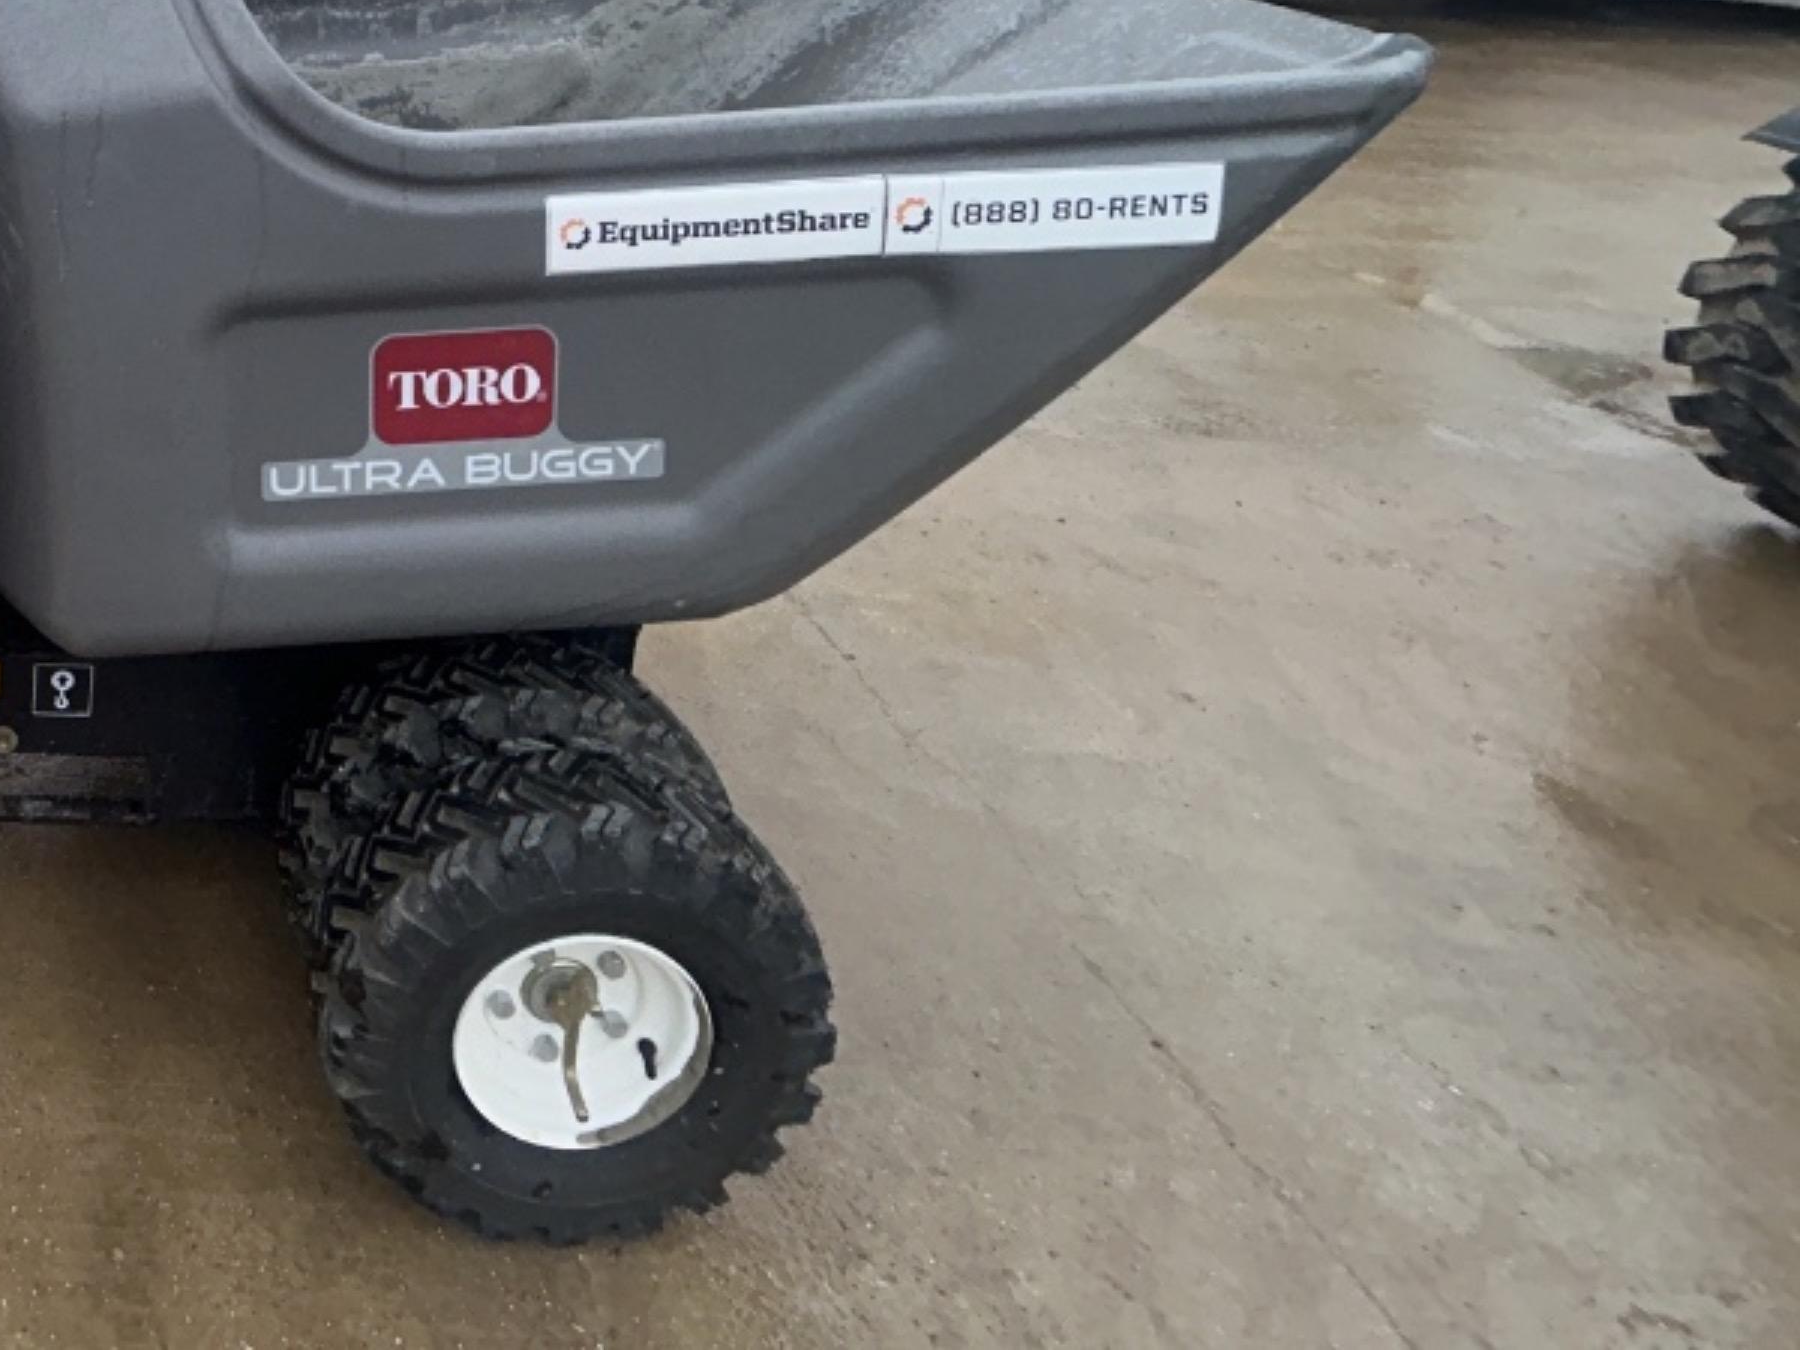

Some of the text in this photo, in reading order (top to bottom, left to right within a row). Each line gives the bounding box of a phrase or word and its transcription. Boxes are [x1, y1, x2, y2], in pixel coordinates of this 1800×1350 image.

[597, 209, 870, 246] EquipmentShare
[951, 192, 1209, 228] (888) 80-RENTS
[388, 363, 542, 411] TORO
[269, 445, 651, 496] ULTRA BUGGY
